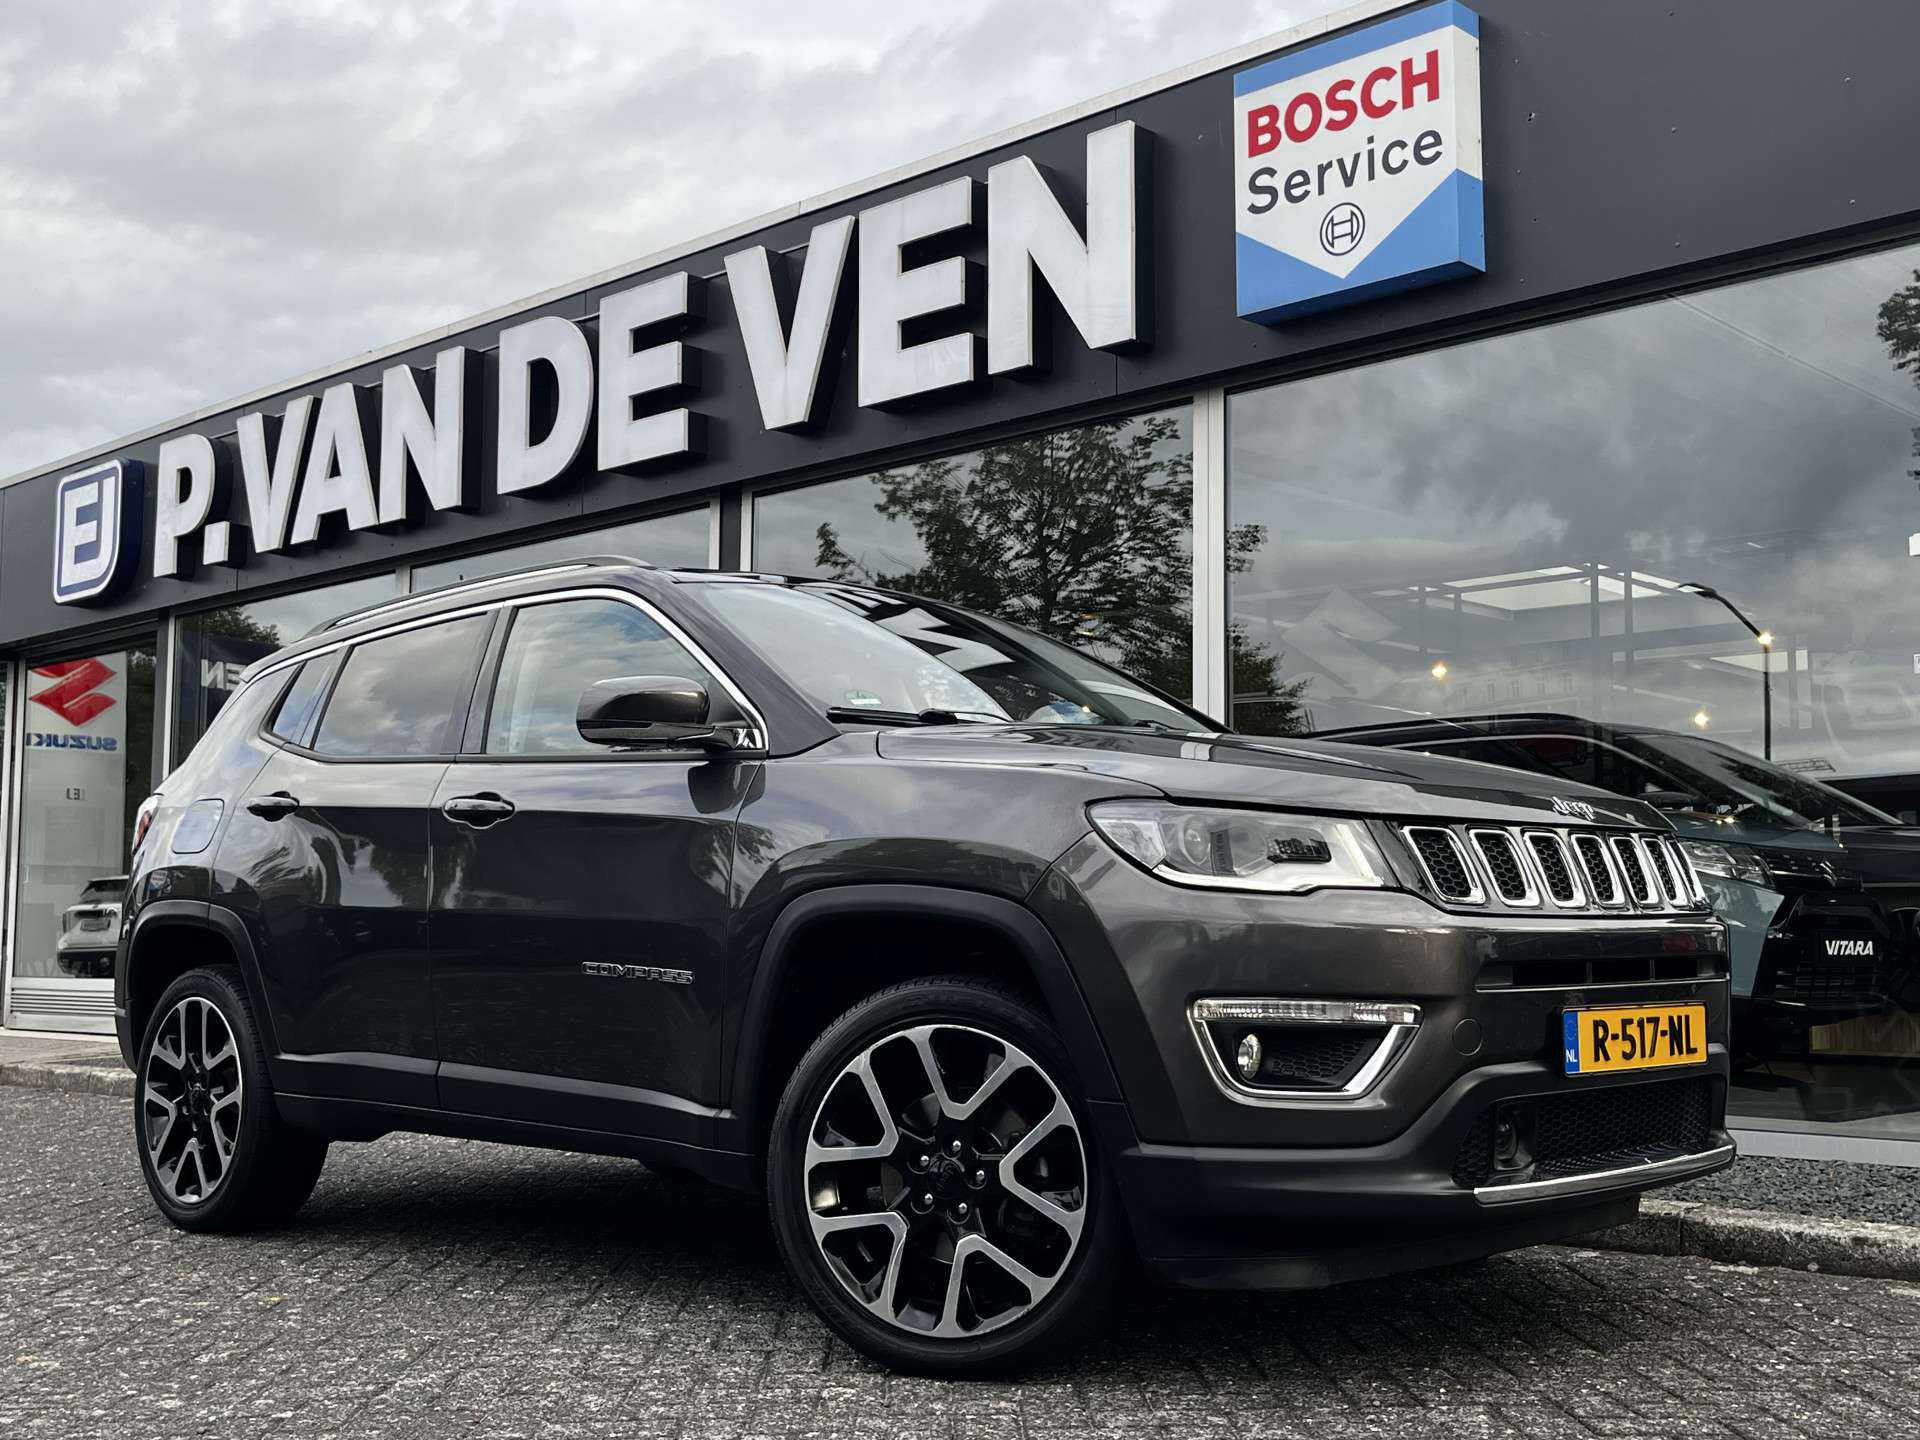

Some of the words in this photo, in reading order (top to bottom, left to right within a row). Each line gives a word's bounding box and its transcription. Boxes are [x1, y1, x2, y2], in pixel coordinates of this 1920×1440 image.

[1247, 49, 1440, 159] BOSCH
[1247, 129, 1443, 215] Service
[497, 271, 689, 495] DE
[723, 120, 1137, 430] VEN
[1825, 940, 1874, 956] VITARA
[582, 961, 693, 985] COMPASS
[1565, 1049, 1578, 1063] NL
[1592, 1014, 1698, 1063] R-517-NL
